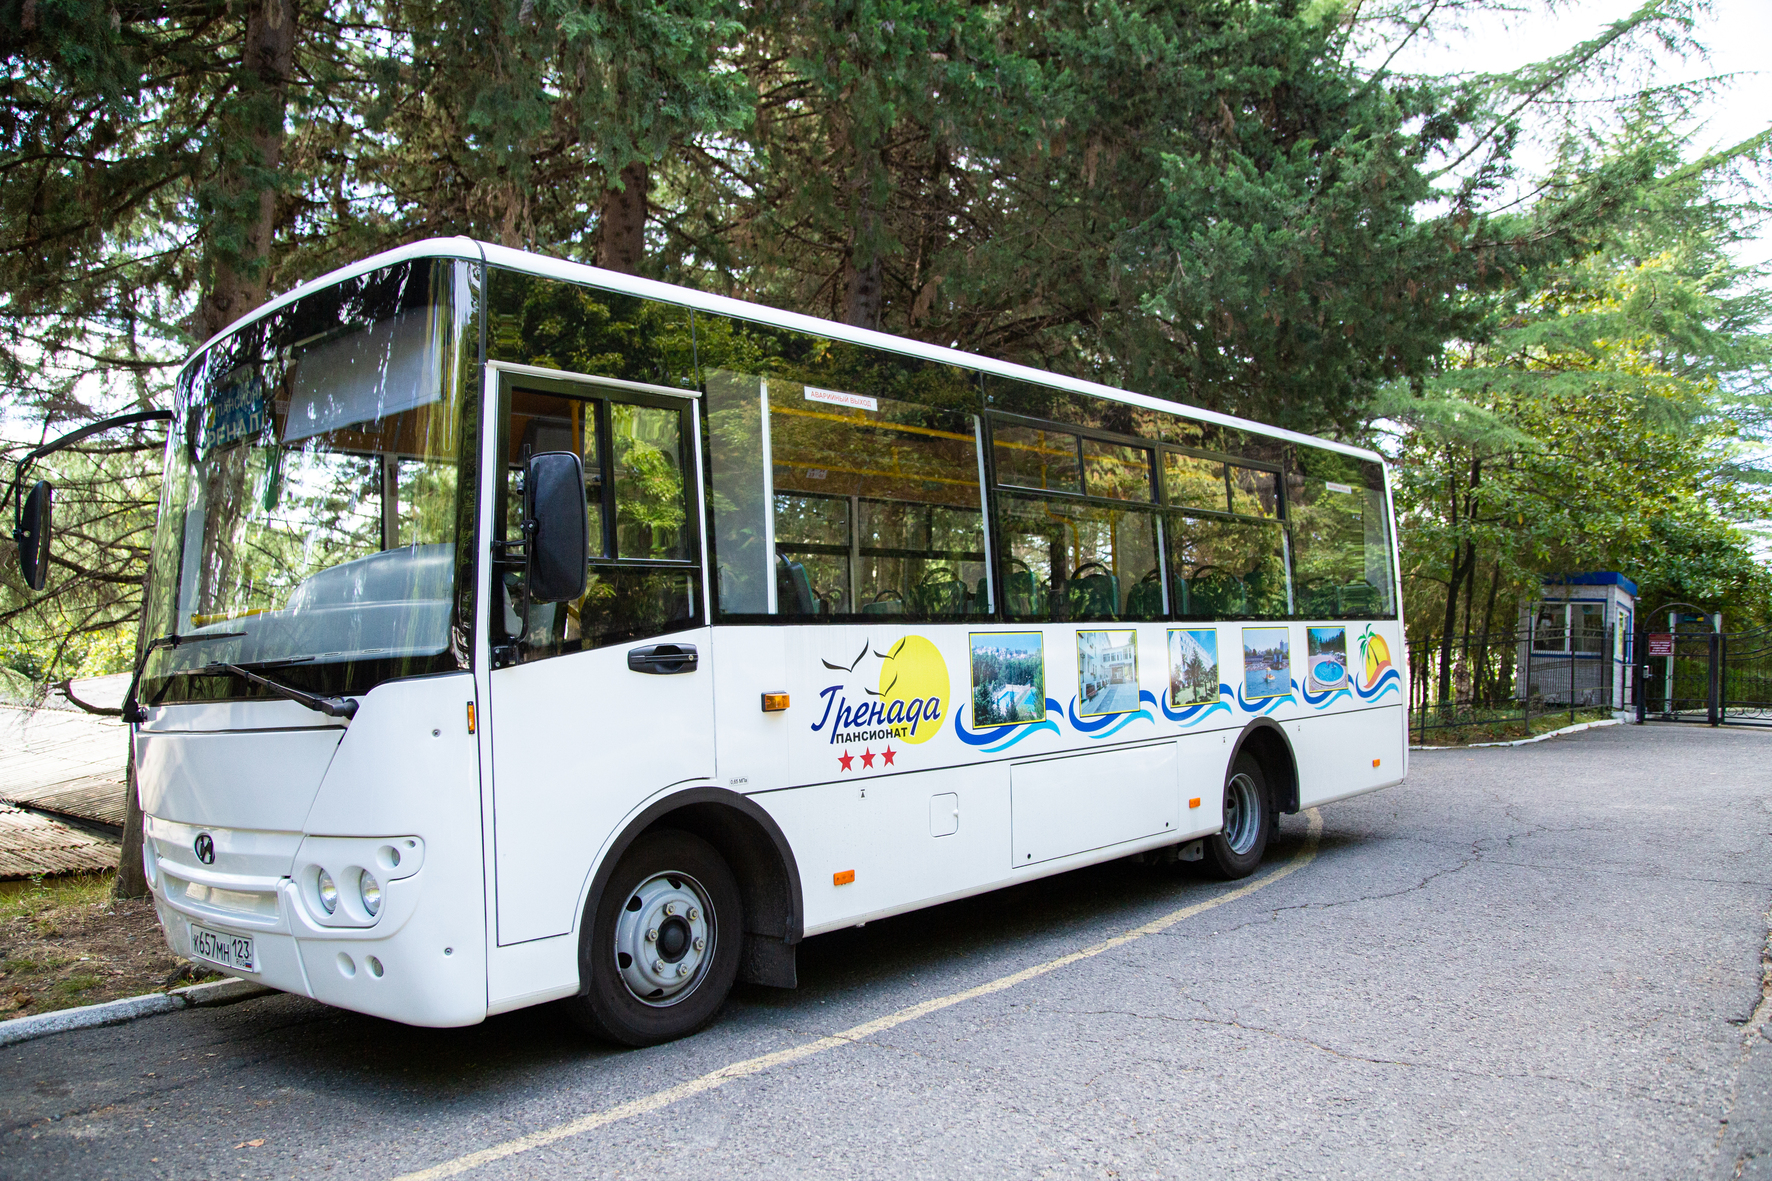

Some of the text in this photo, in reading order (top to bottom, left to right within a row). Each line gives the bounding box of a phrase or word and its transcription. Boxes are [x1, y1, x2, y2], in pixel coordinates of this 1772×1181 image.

[811, 390, 872, 408] АВАРИЙНЫЙ ВЫХОД
[810, 684, 941, 745] Гренада
[836, 727, 908, 744] ПАНСИОНАТ
[193, 931, 250, 963] К657МН 123
